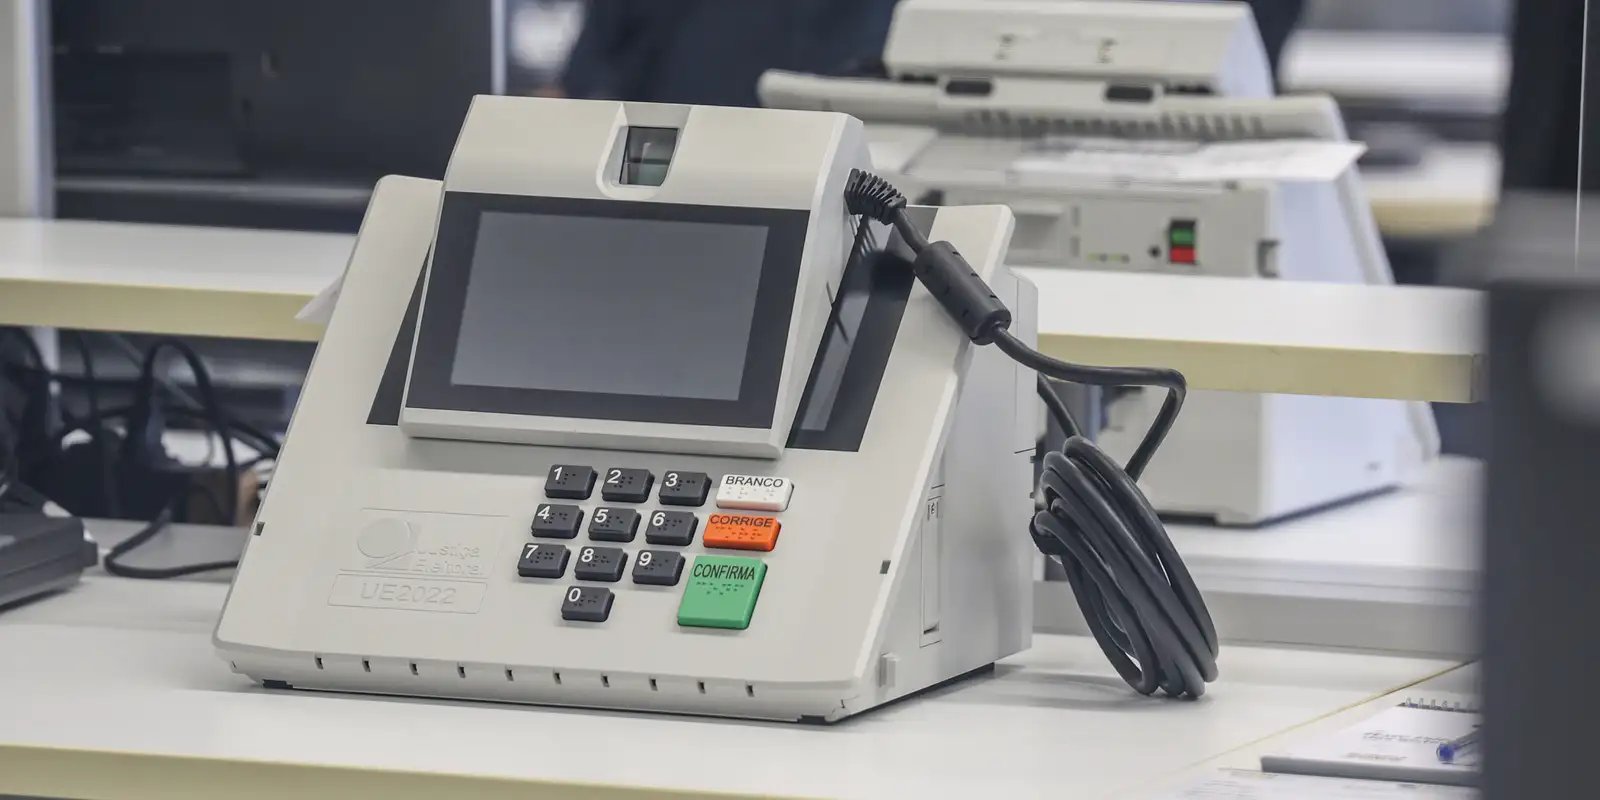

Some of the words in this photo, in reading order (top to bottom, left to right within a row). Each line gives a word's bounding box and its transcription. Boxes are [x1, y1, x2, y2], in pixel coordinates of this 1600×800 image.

[553, 466, 562, 481] 1
[607, 469, 622, 484] 2
[665, 473, 677, 487] 3
[725, 475, 784, 488] BRANCO
[537, 505, 550, 520] 4
[594, 508, 608, 523] 5
[652, 512, 665, 526] 6
[710, 514, 773, 528] CORRIGE
[526, 544, 539, 559] 7
[581, 548, 593, 563] 8
[639, 551, 652, 566] 9
[693, 563, 756, 580] CONFIRMA
[360, 582, 457, 604] UE2022
[568, 587, 581, 602] 0
